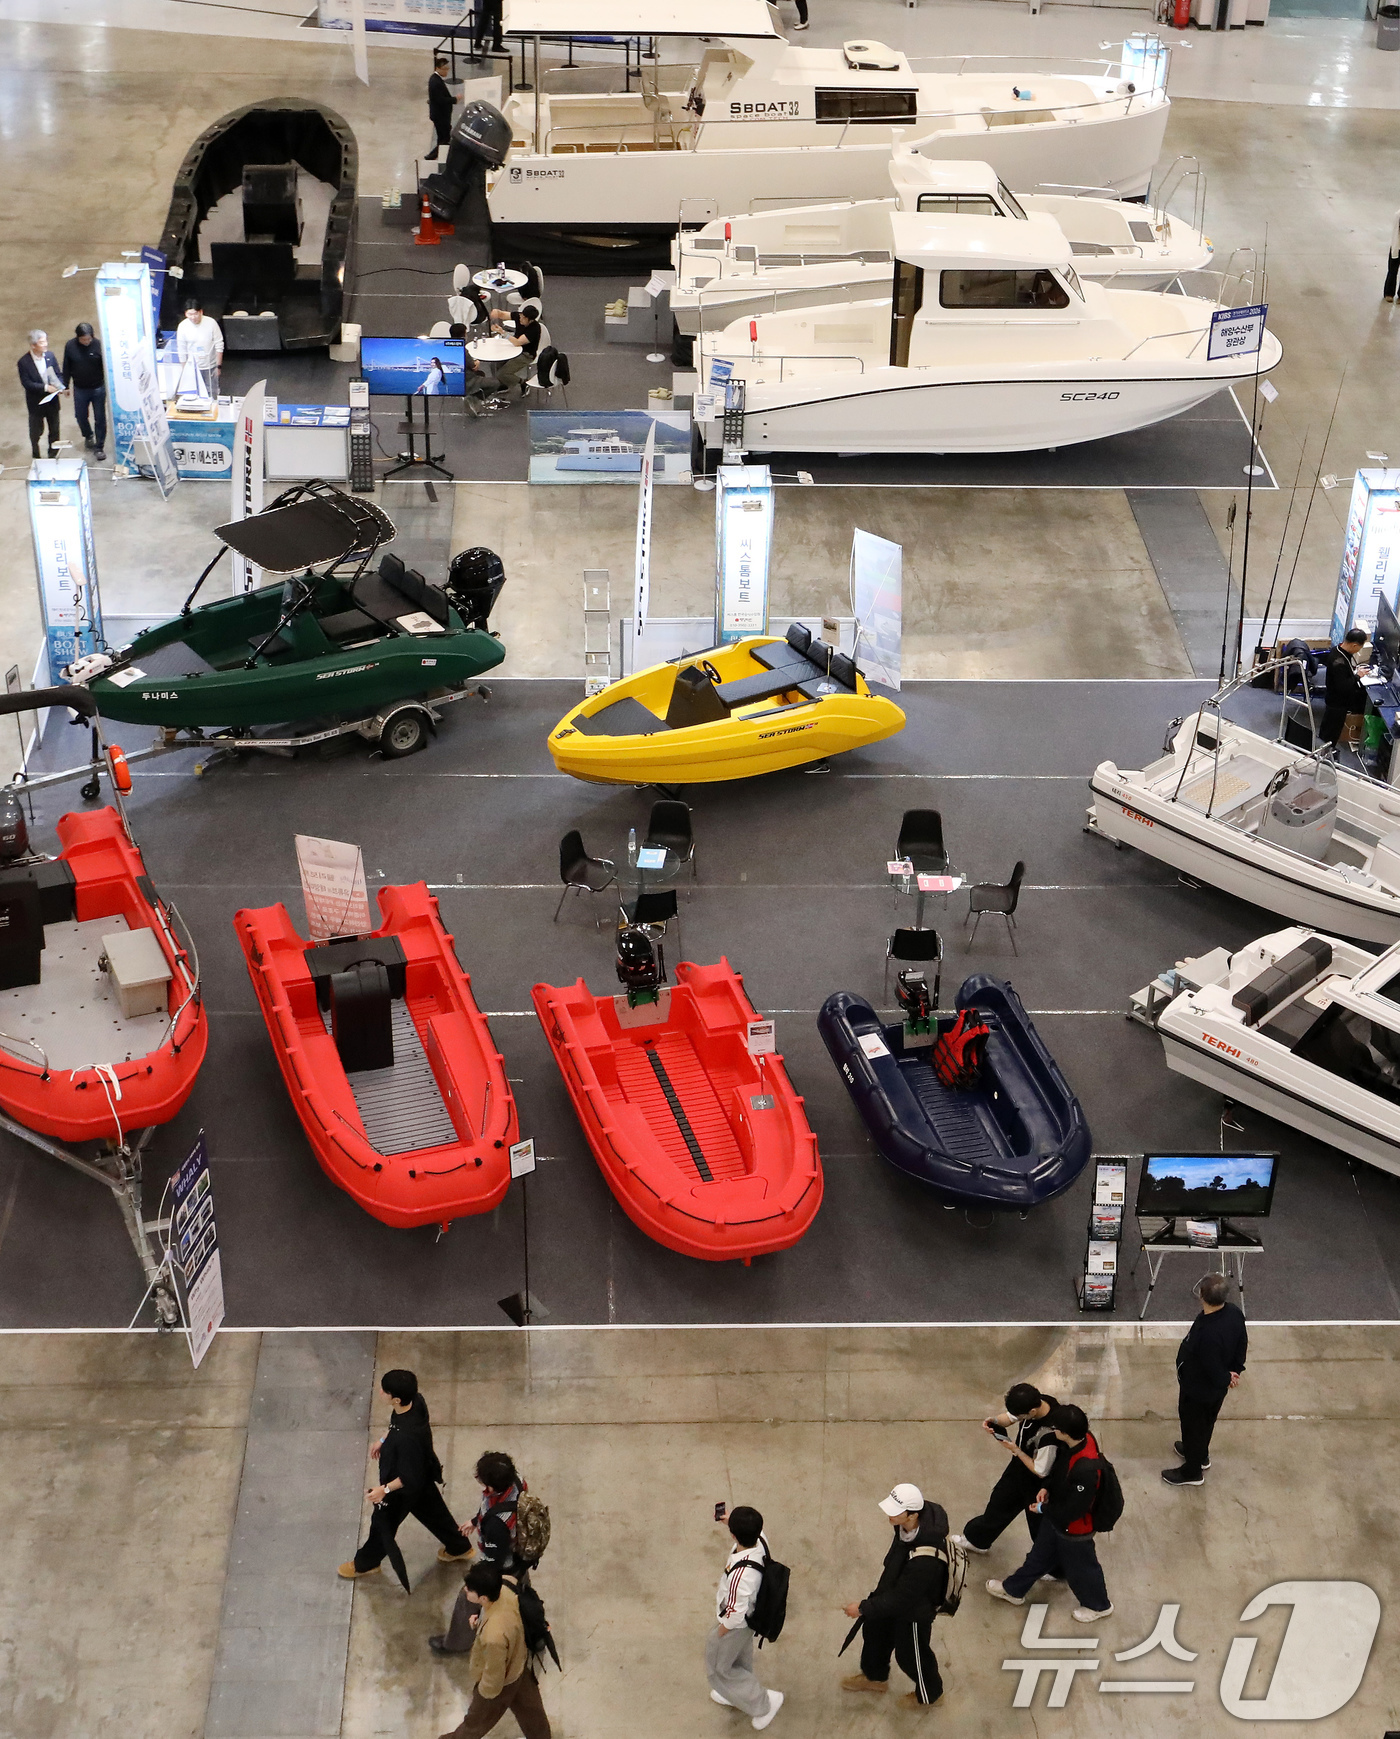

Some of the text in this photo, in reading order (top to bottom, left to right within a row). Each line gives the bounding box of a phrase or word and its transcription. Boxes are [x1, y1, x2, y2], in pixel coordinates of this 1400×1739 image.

[730, 102, 788, 113] SBOAT
[526, 169, 558, 177] SBOAT
[1220, 323, 1255, 337] 해양수산부
[1225, 336, 1247, 348] 장관상
[1060, 391, 1121, 402] SC240
[53, 539, 72, 592] 테리보트
[737, 539, 752, 603] 씨스톰보트
[142, 692, 179, 700] 두나미스
[1121, 806, 1154, 828] TERHI
[1202, 1032, 1242, 1058] TERHI
[176, 1153, 202, 1198] WHALY
